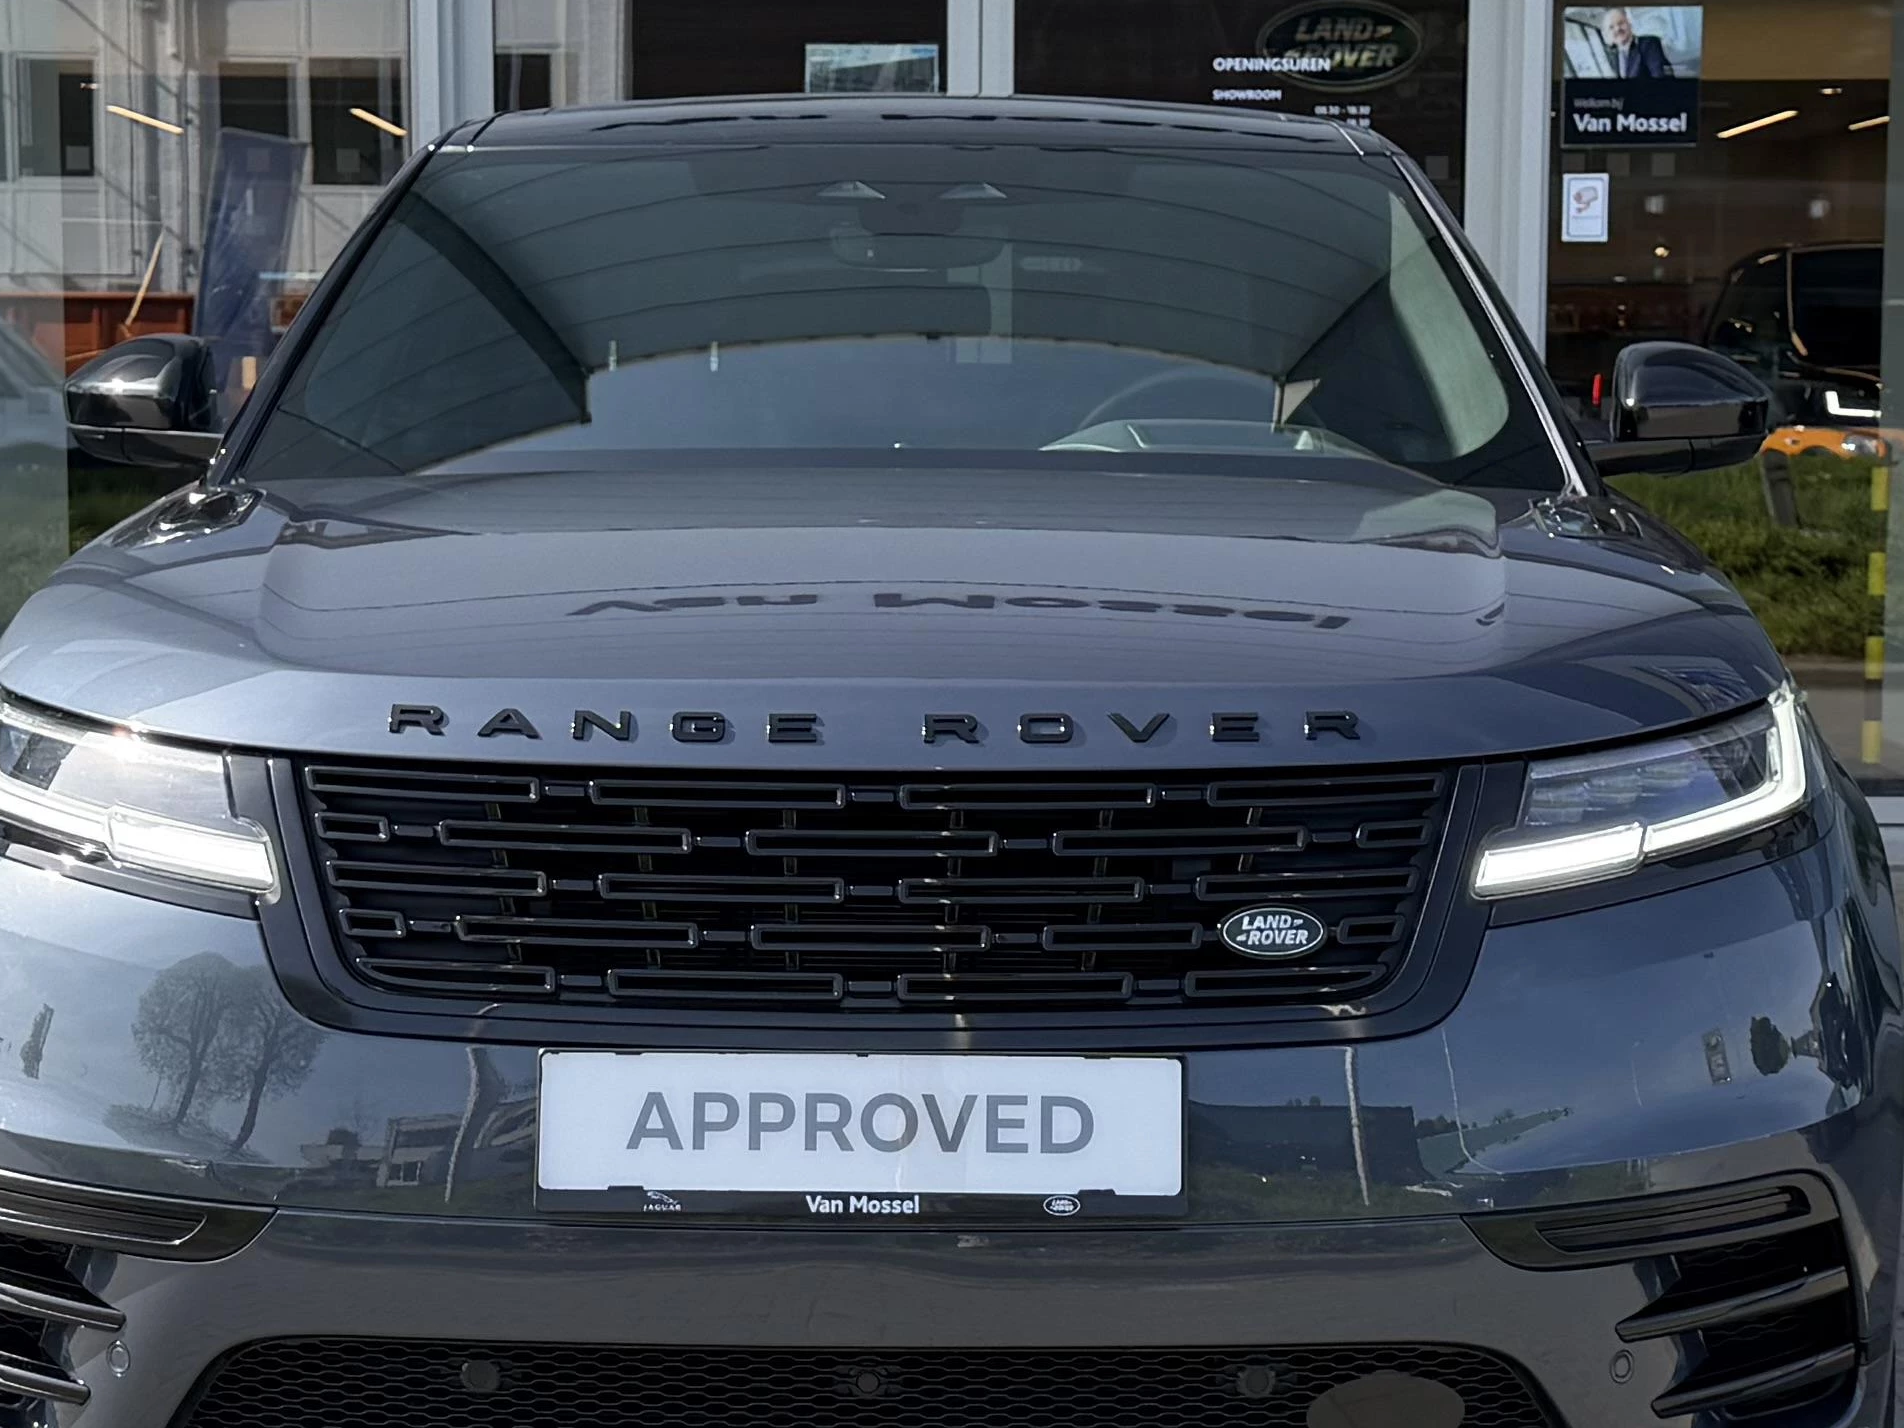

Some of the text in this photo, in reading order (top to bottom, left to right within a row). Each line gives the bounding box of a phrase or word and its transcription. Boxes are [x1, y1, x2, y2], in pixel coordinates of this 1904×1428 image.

[1294, 17, 1373, 42] LAND
[1212, 56, 1332, 73] OPENINGSUREN
[1212, 89, 1283, 101] SHOWROOM
[1573, 112, 1688, 132] Van Mossel
[387, 703, 1361, 745] RANGE ROVER
[1241, 914, 1292, 930] LAND
[1247, 929, 1309, 945] ROVER
[625, 1091, 1095, 1155] APPROVED
[643, 1203, 682, 1212] JAGUAR
[805, 1194, 920, 1214] Van Mossel
